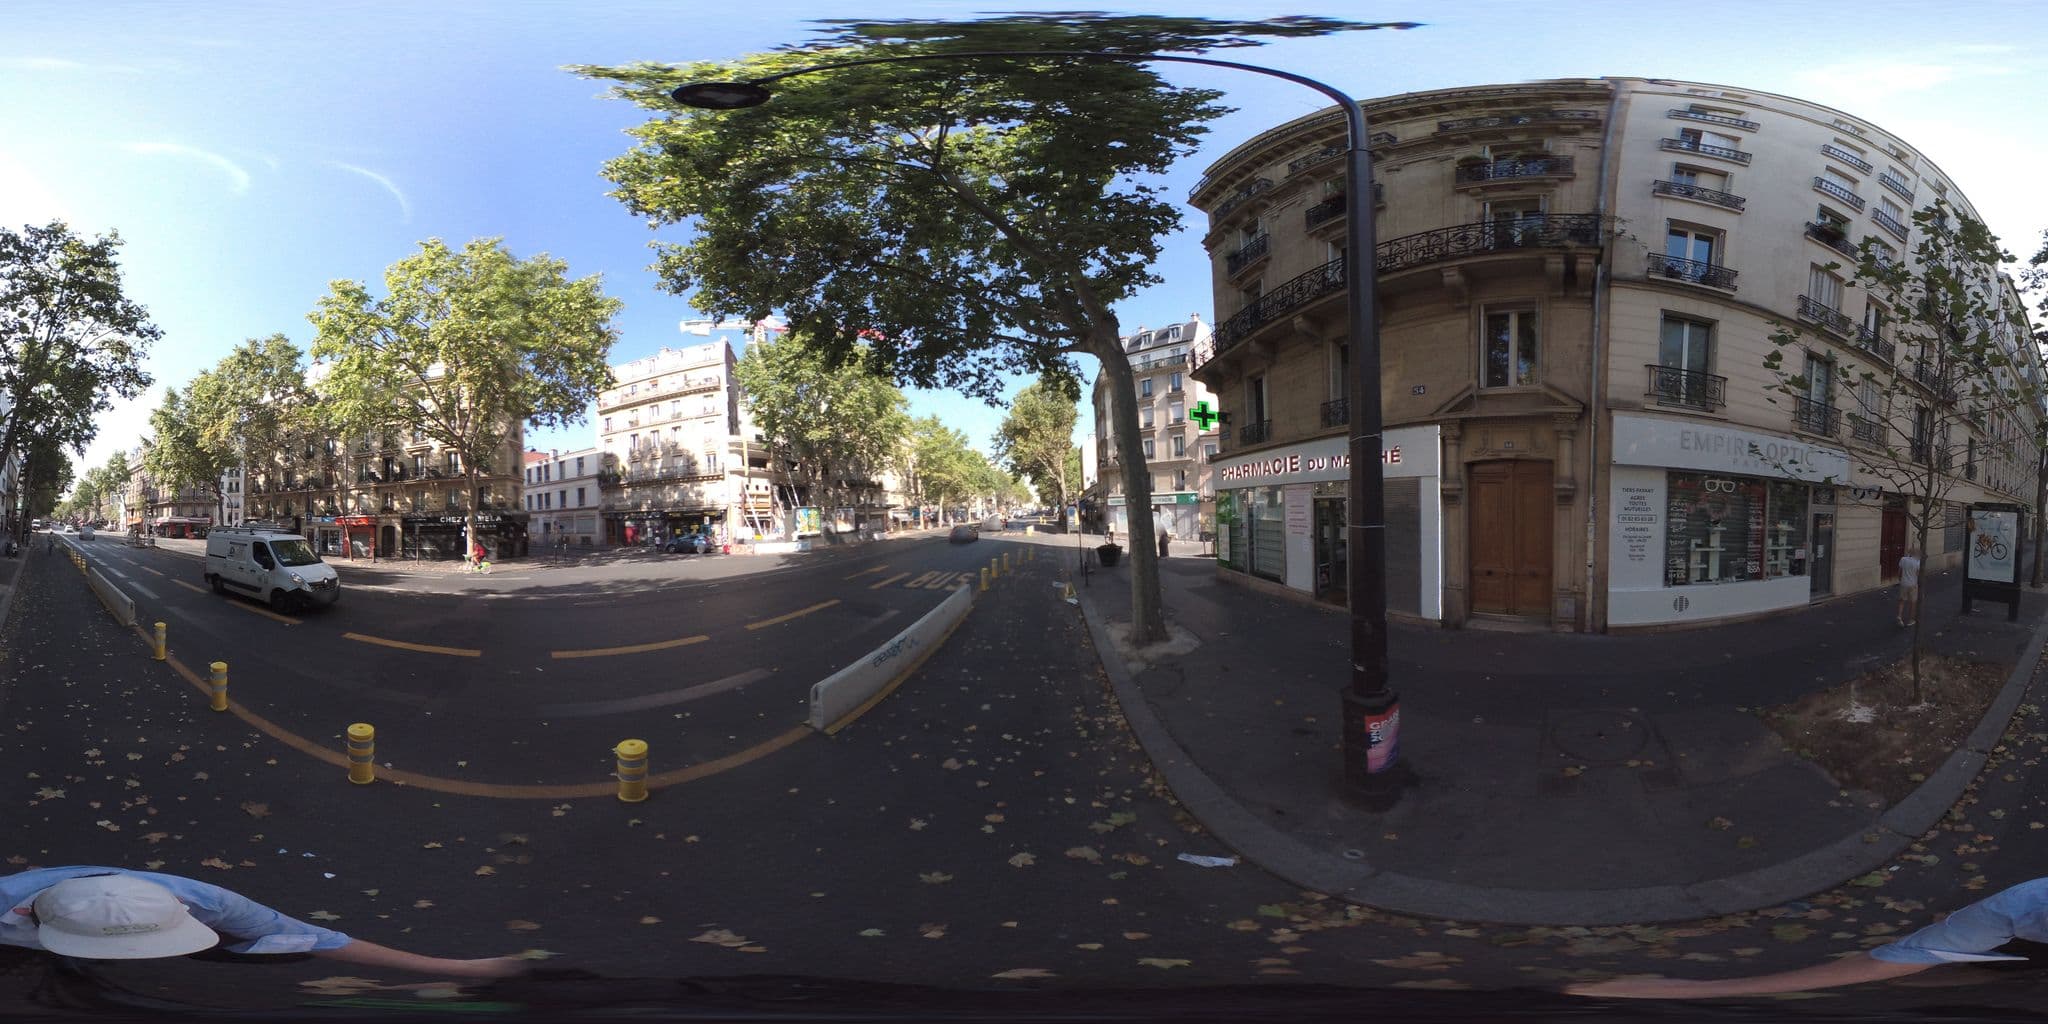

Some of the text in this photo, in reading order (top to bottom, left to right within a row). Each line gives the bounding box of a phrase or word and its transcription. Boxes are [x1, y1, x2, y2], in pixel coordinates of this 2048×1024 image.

[1221, 445, 1401, 481] PHARMACIE DU MAHÉ
[904, 570, 976, 591] BUS
